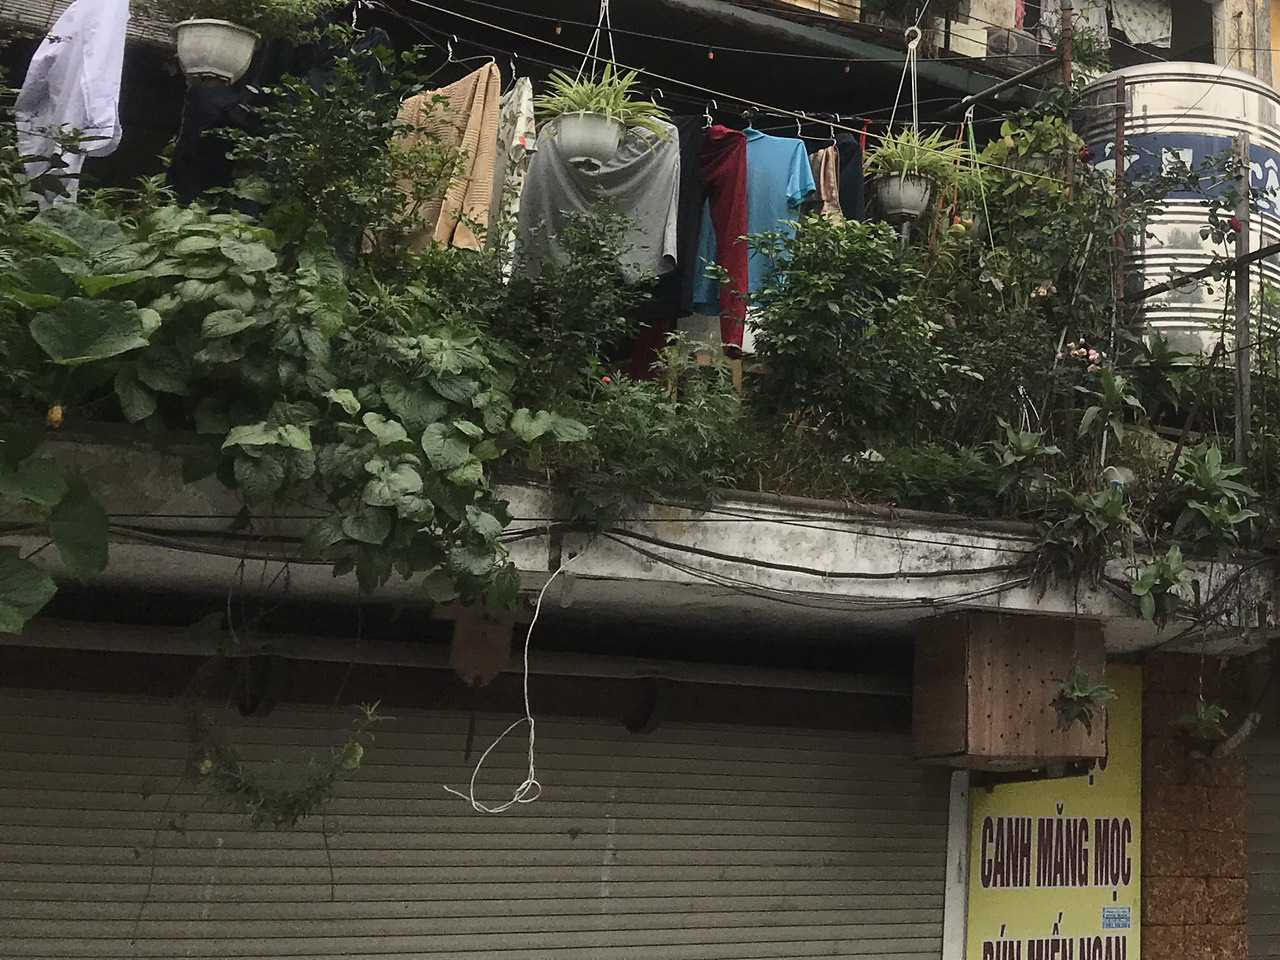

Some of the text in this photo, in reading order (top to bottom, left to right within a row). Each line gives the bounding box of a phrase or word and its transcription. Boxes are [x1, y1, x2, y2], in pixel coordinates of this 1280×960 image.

[980, 800, 1132, 902] CANH MĂNG MỌC
